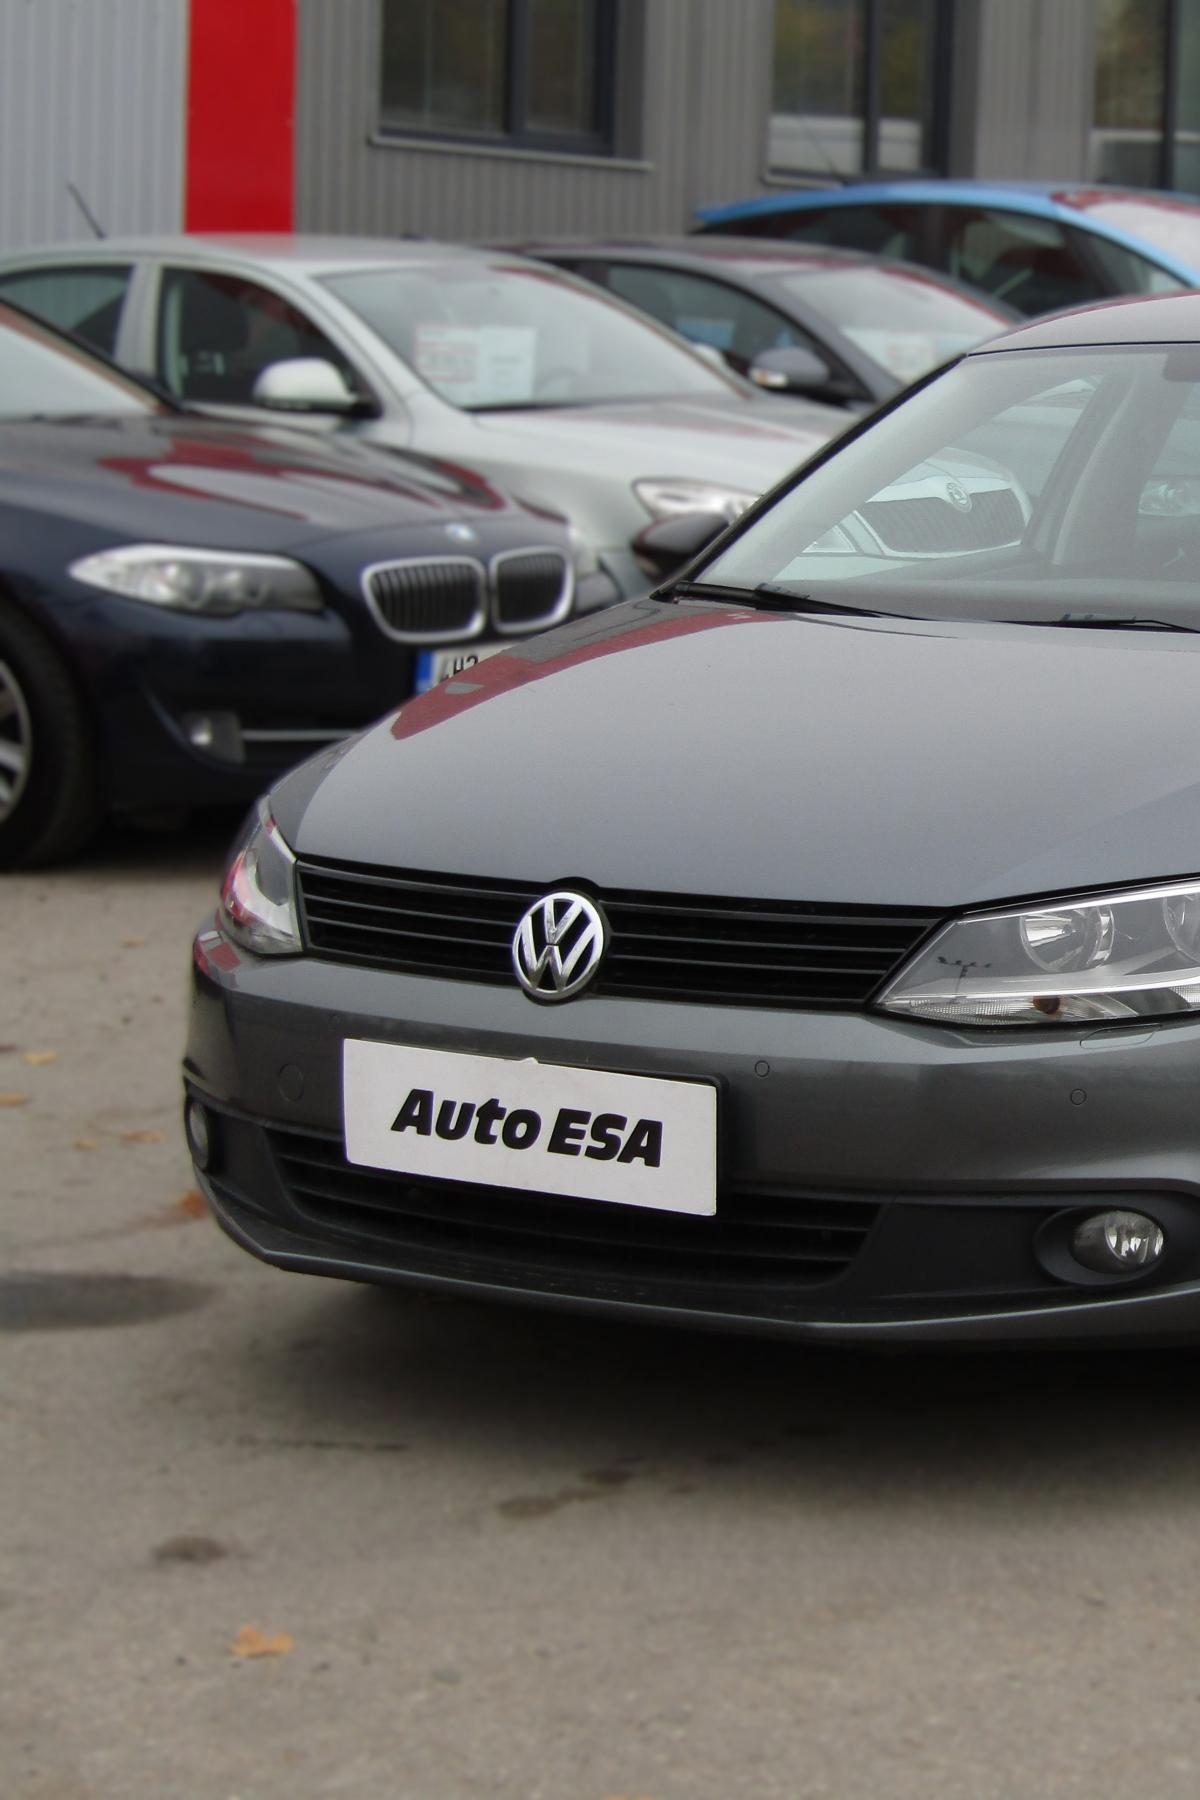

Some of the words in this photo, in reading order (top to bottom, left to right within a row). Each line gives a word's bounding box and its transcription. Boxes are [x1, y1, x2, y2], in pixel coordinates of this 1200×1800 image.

[513, 892, 604, 1000] VW
[391, 1088, 541, 1150] Auto
[547, 1107, 664, 1168] ESA
